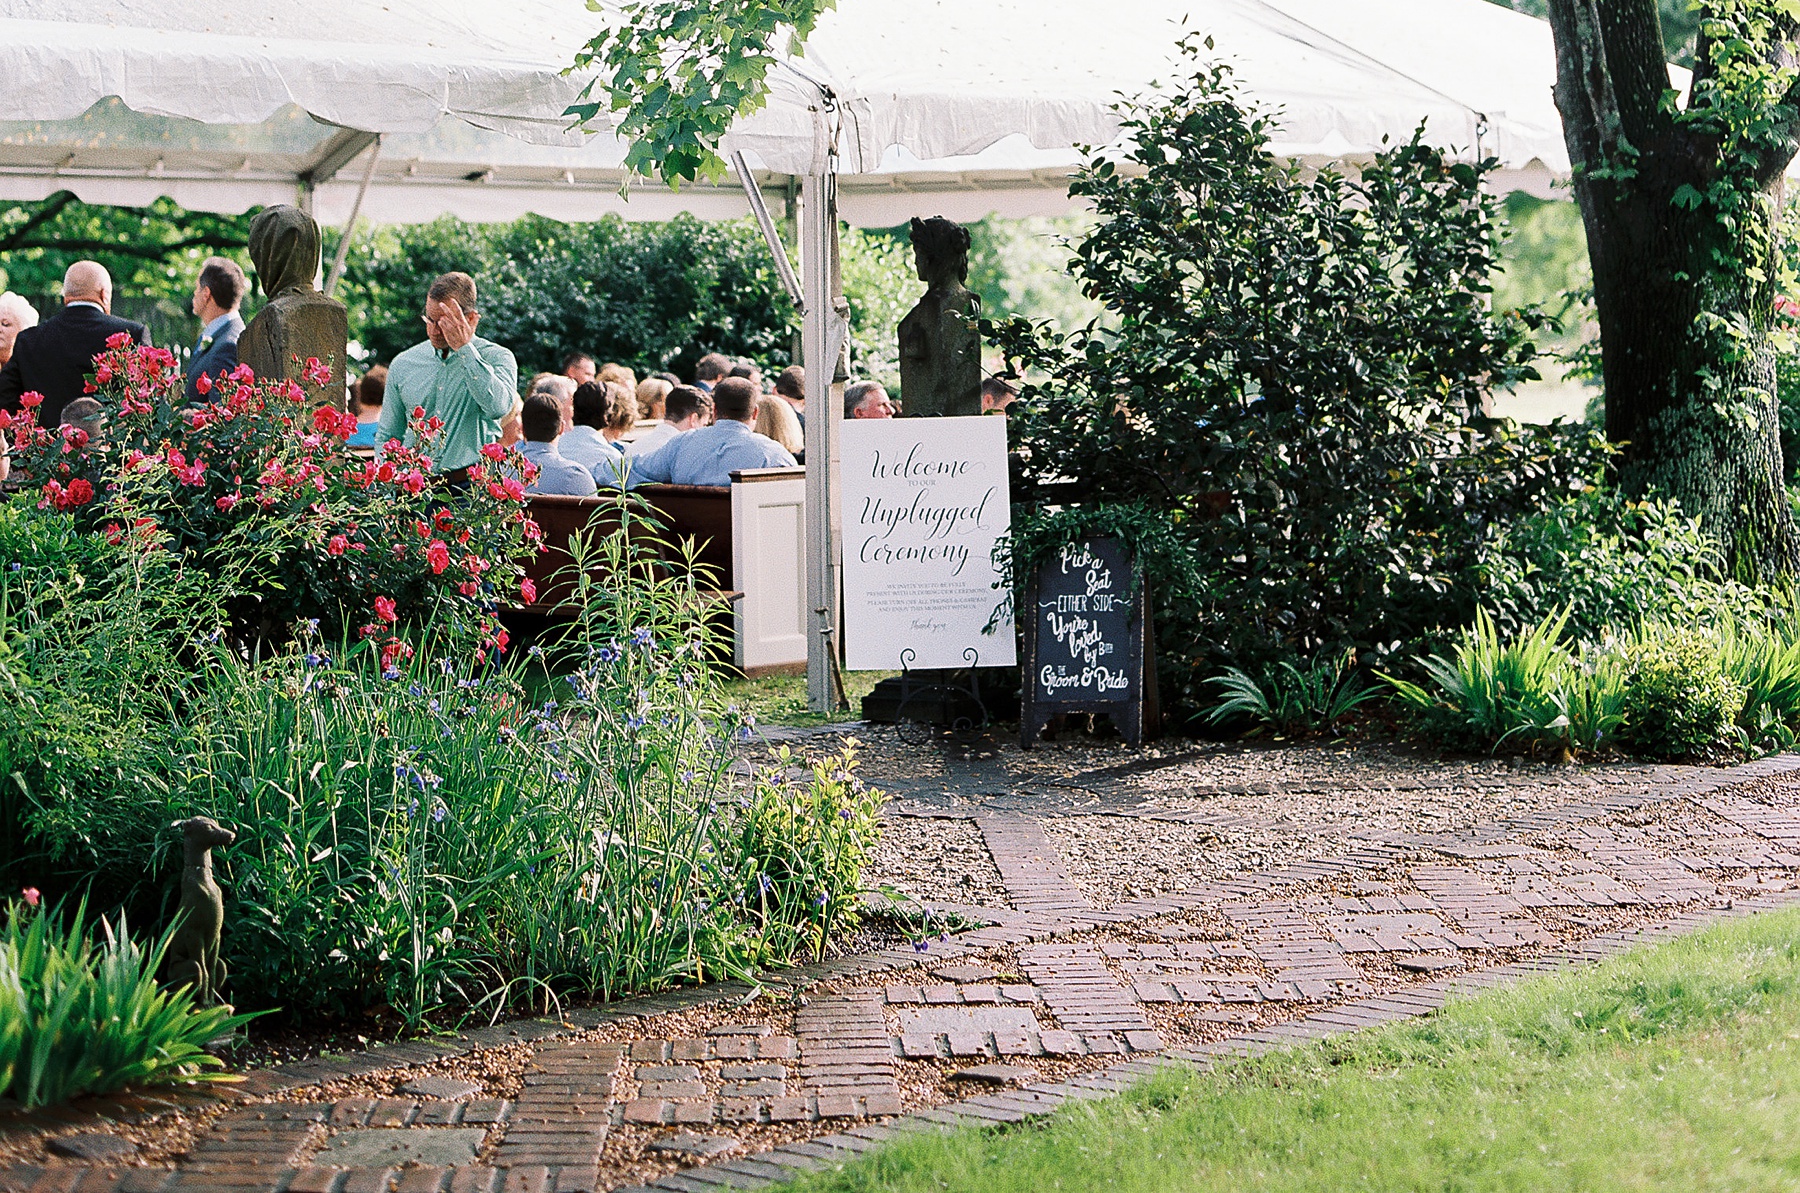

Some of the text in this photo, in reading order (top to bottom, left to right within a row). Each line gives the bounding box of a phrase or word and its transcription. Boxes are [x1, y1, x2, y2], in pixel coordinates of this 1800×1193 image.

[868, 442, 986, 478] Welcome
[860, 486, 998, 541] Unplugged
[860, 535, 981, 576] Ceremony
[1059, 542, 1104, 574] Pick a
[1086, 568, 1113, 597] Seat
[1057, 594, 1115, 613] EITHER SIDE
[1069, 620, 1102, 658] loved
[1084, 646, 1098, 668] by
[1041, 664, 1129, 695] Groom & Bride
